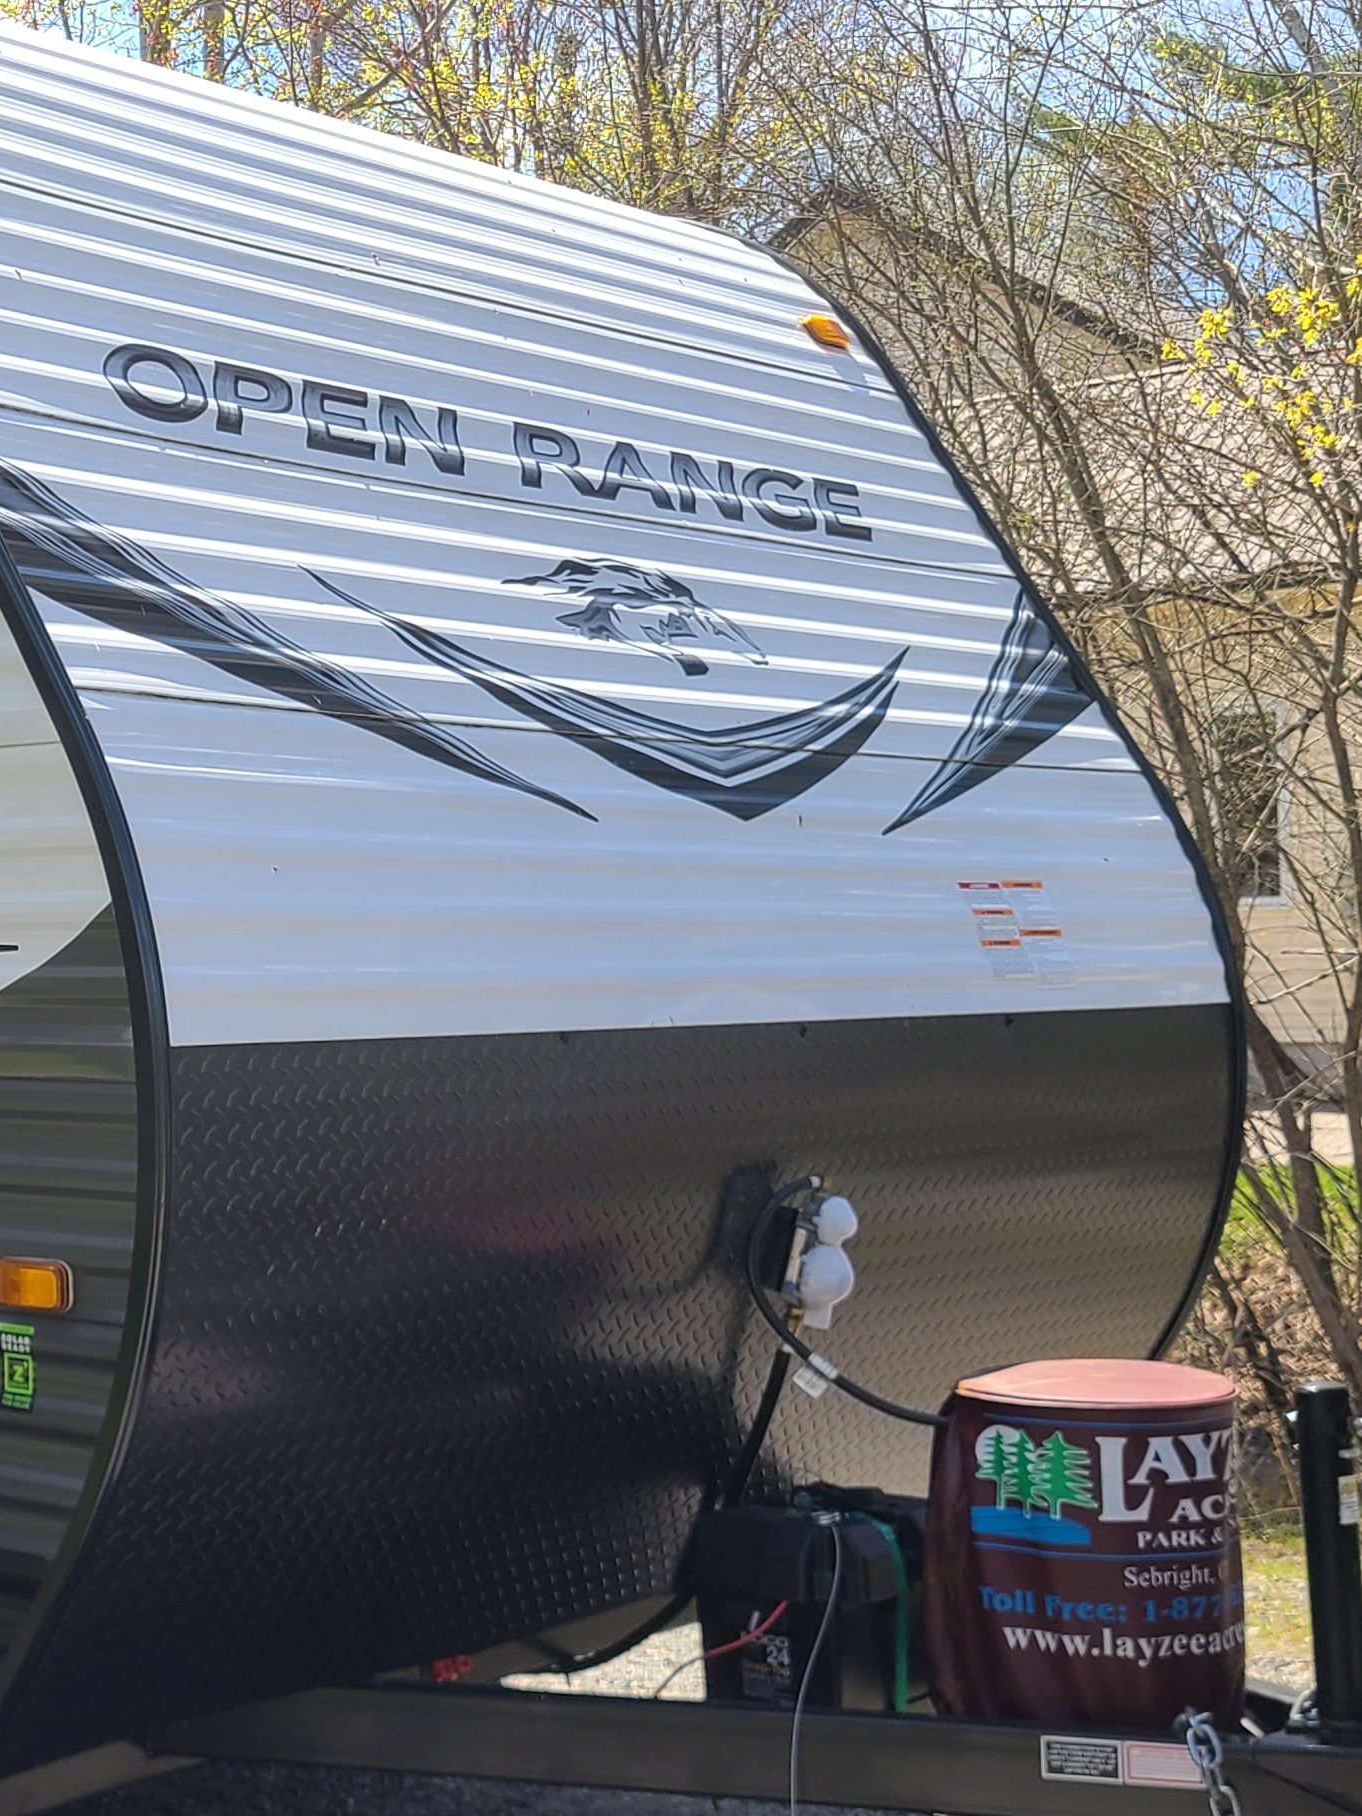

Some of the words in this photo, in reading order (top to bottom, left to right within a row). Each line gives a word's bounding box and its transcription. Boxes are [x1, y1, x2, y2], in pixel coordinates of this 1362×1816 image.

[101, 343, 466, 477] OPEN
[512, 421, 874, 543] RANGE
[1137, 1529, 1205, 1549] PARK
[1123, 1563, 1215, 1590] Sebright,
[978, 1585, 1035, 1613] Toll
[1044, 1594, 1128, 1622] Free:
[766, 1645, 790, 1666] 24
